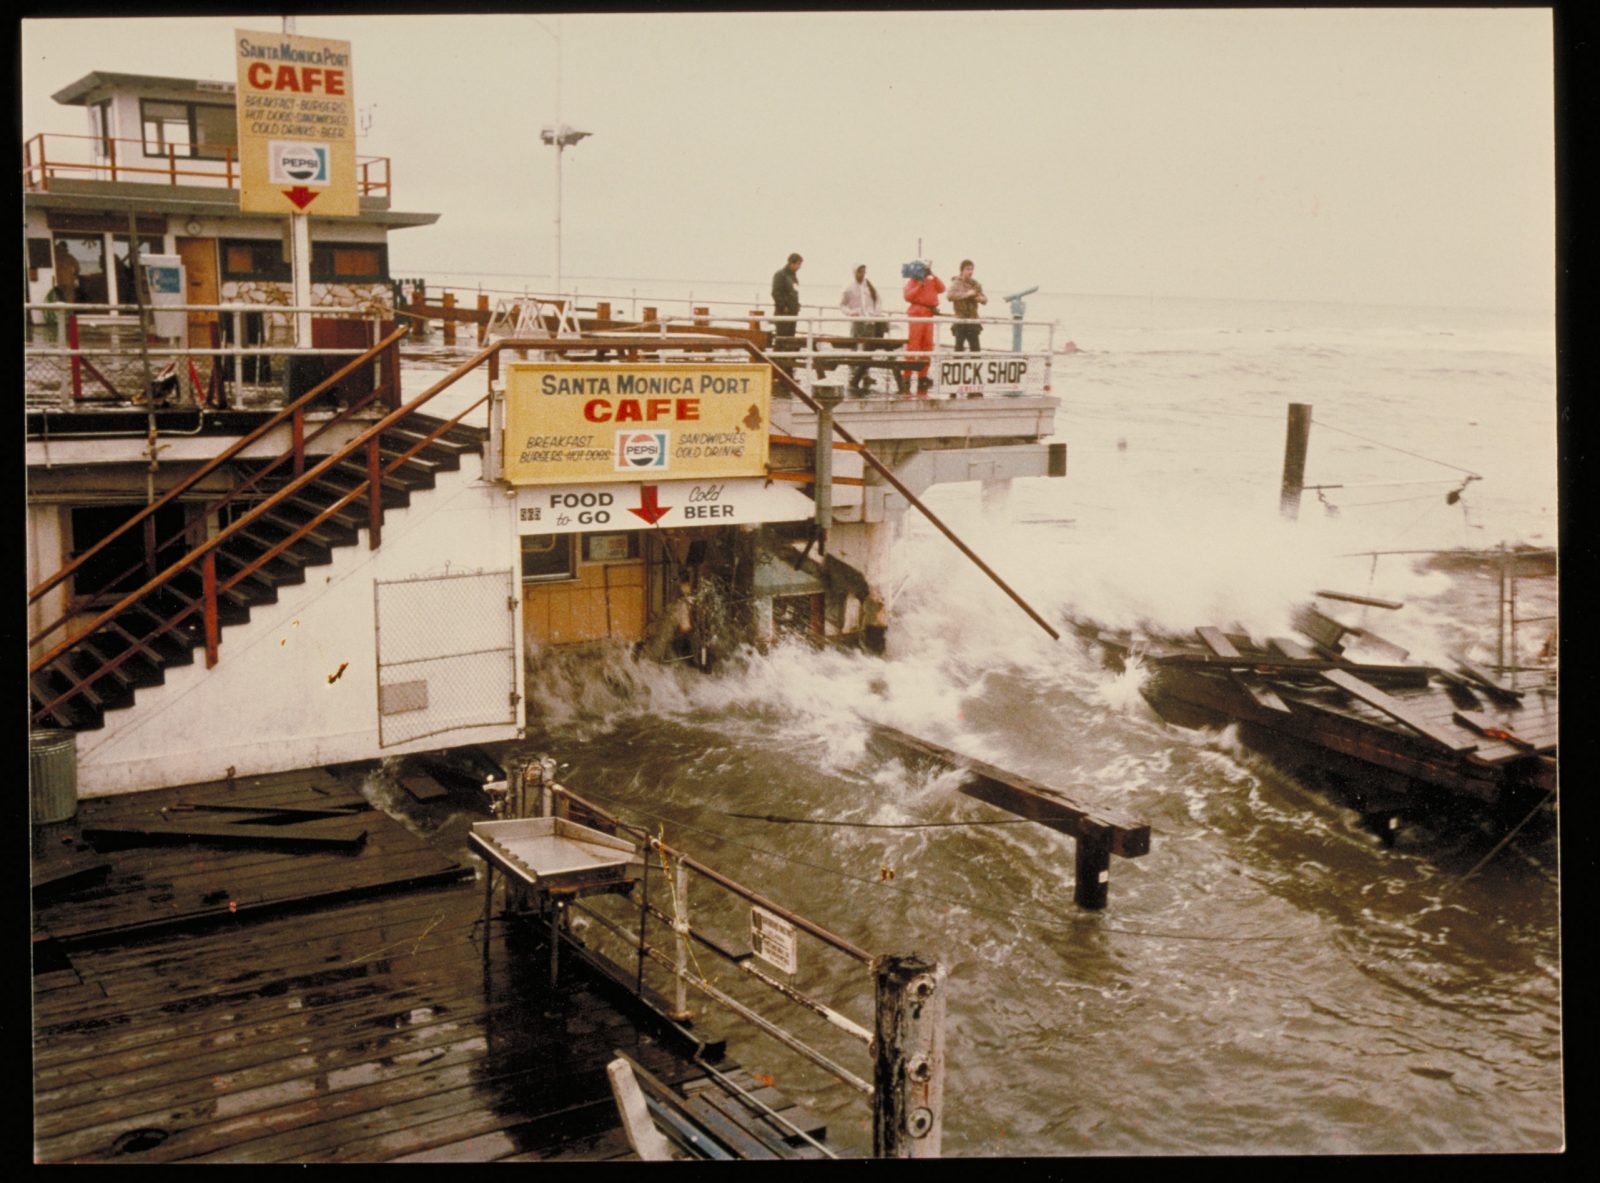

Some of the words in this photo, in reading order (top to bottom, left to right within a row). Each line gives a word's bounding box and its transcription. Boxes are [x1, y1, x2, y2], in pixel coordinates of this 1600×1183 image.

[239, 38, 278, 60] SANTA
[279, 43, 323, 64] MONICA
[323, 47, 349, 67] PORT
[247, 61, 345, 95] CAFE
[282, 157, 318, 168] PEPSI
[941, 362, 983, 386] ROCK
[987, 361, 1027, 384] SHOP
[542, 374, 611, 395] SANTA
[616, 374, 695, 395] MONICA
[700, 374, 751, 394] PORT
[583, 398, 701, 423] CAFE
[526, 435, 594, 449] BREAKFAST
[678, 432, 746, 445] SANDWICHES
[626, 445, 658, 456] PEPSI
[676, 446, 702, 459] COLD
[550, 492, 614, 508] FOOD
[688, 485, 725, 502] Cold
[556, 513, 571, 526] to
[578, 511, 611, 525] GO
[684, 505, 735, 519] BEER
